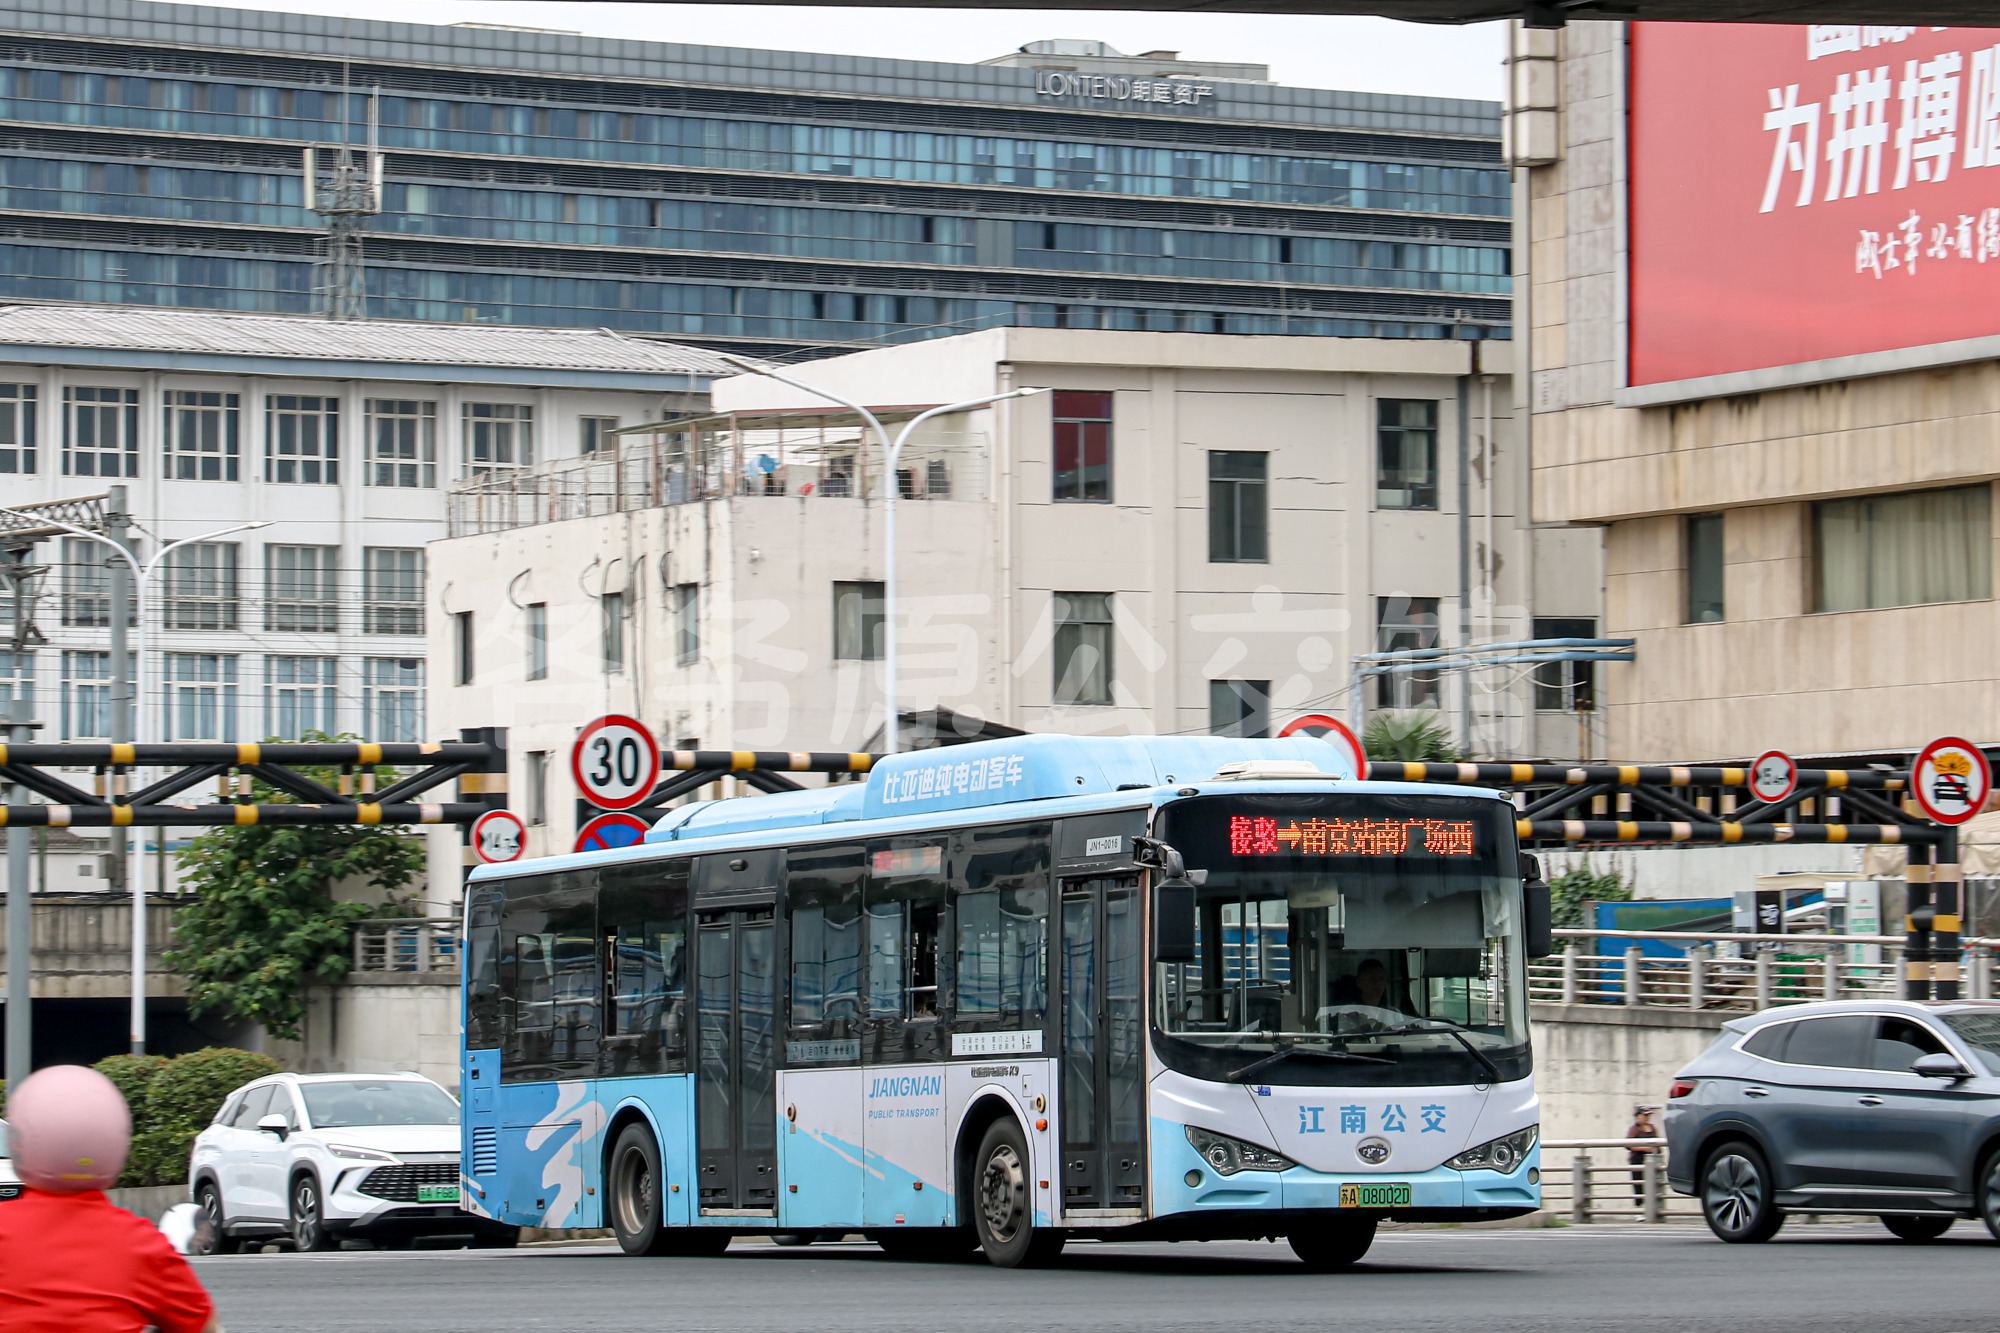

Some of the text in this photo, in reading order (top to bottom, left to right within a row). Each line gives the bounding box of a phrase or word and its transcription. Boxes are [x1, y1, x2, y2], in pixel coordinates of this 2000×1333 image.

[1035, 71, 1131, 100] LONTEND
[589, 736, 639, 787] 30
[882, 753, 1025, 805] 比亚迪纯电动客车
[869, 1075, 941, 1099] JIANGNAN
[868, 1107, 940, 1119] PUBLIC TRANSPORT
[1298, 1104, 1447, 1135] 江南公交
